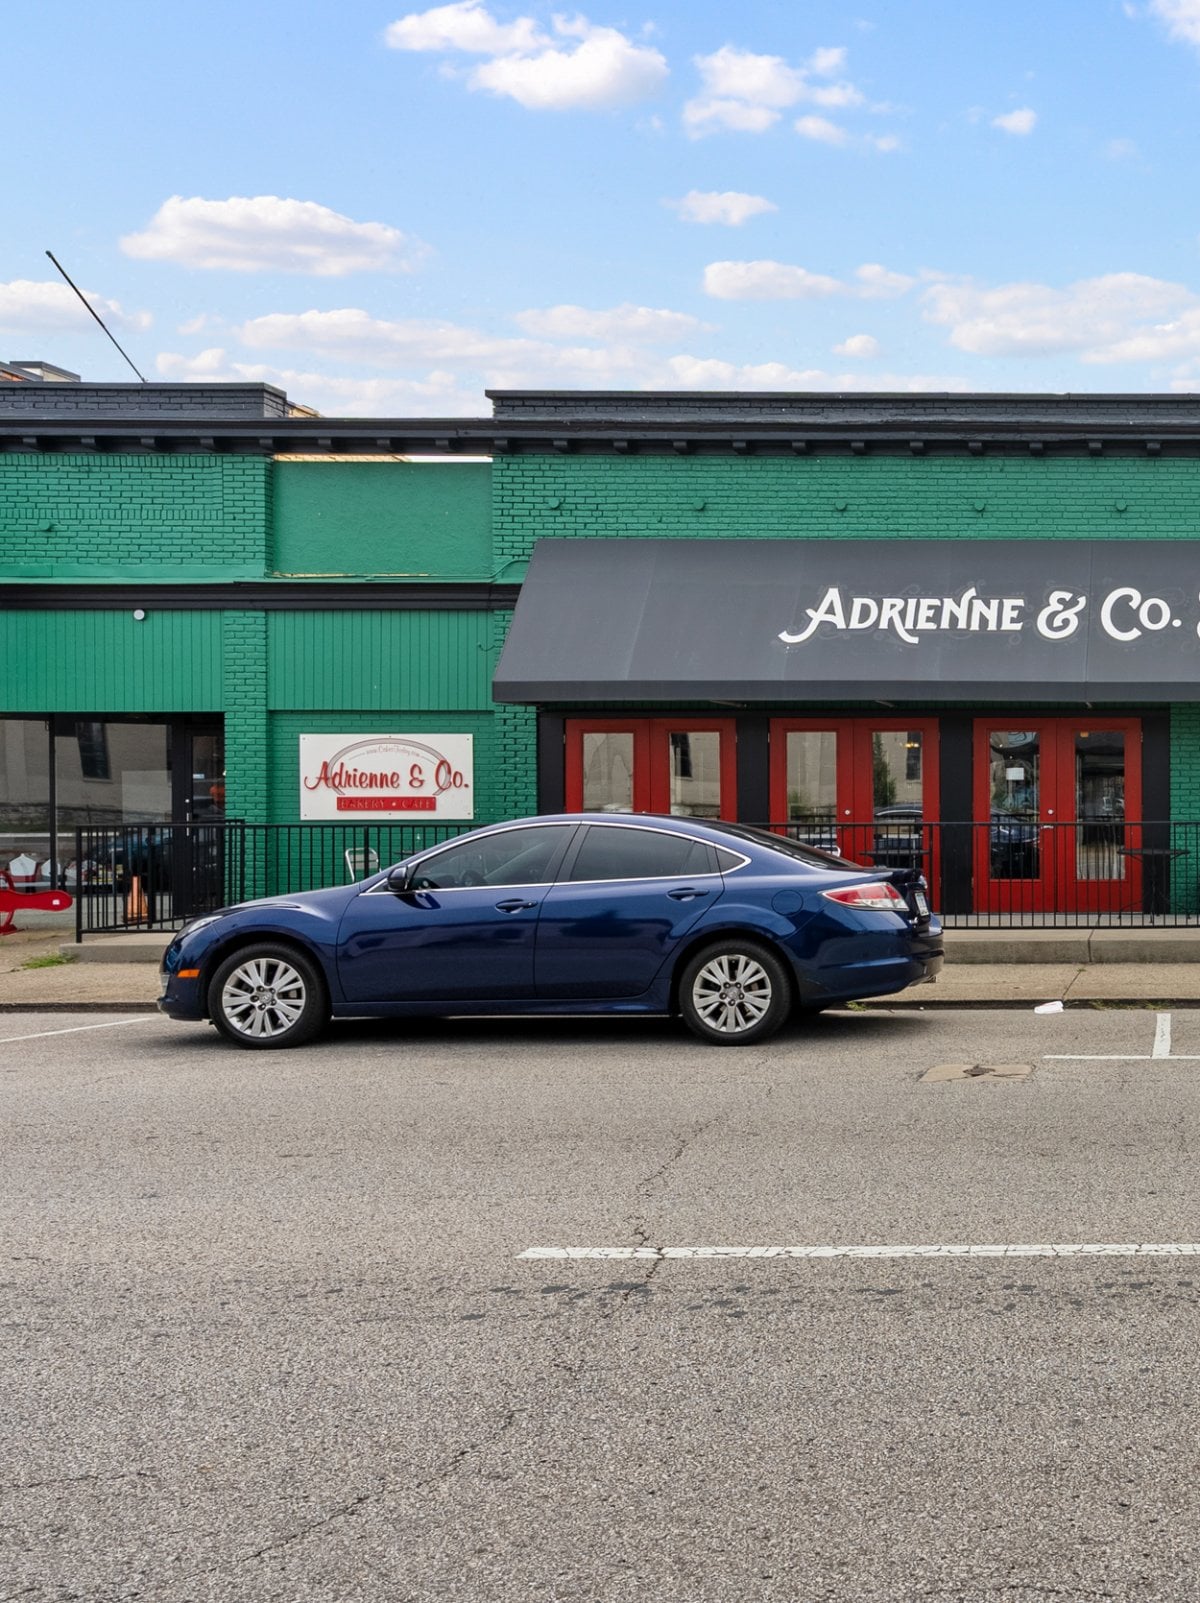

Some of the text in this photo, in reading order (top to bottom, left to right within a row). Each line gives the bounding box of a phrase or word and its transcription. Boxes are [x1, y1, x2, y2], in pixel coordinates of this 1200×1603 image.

[778, 587, 1024, 644] ADRIENNE
[1036, 590, 1086, 640] &
[1101, 587, 1182, 641] CO.
[304, 759, 469, 790] Adrienne & Co.
[341, 799, 385, 809] BAKERY
